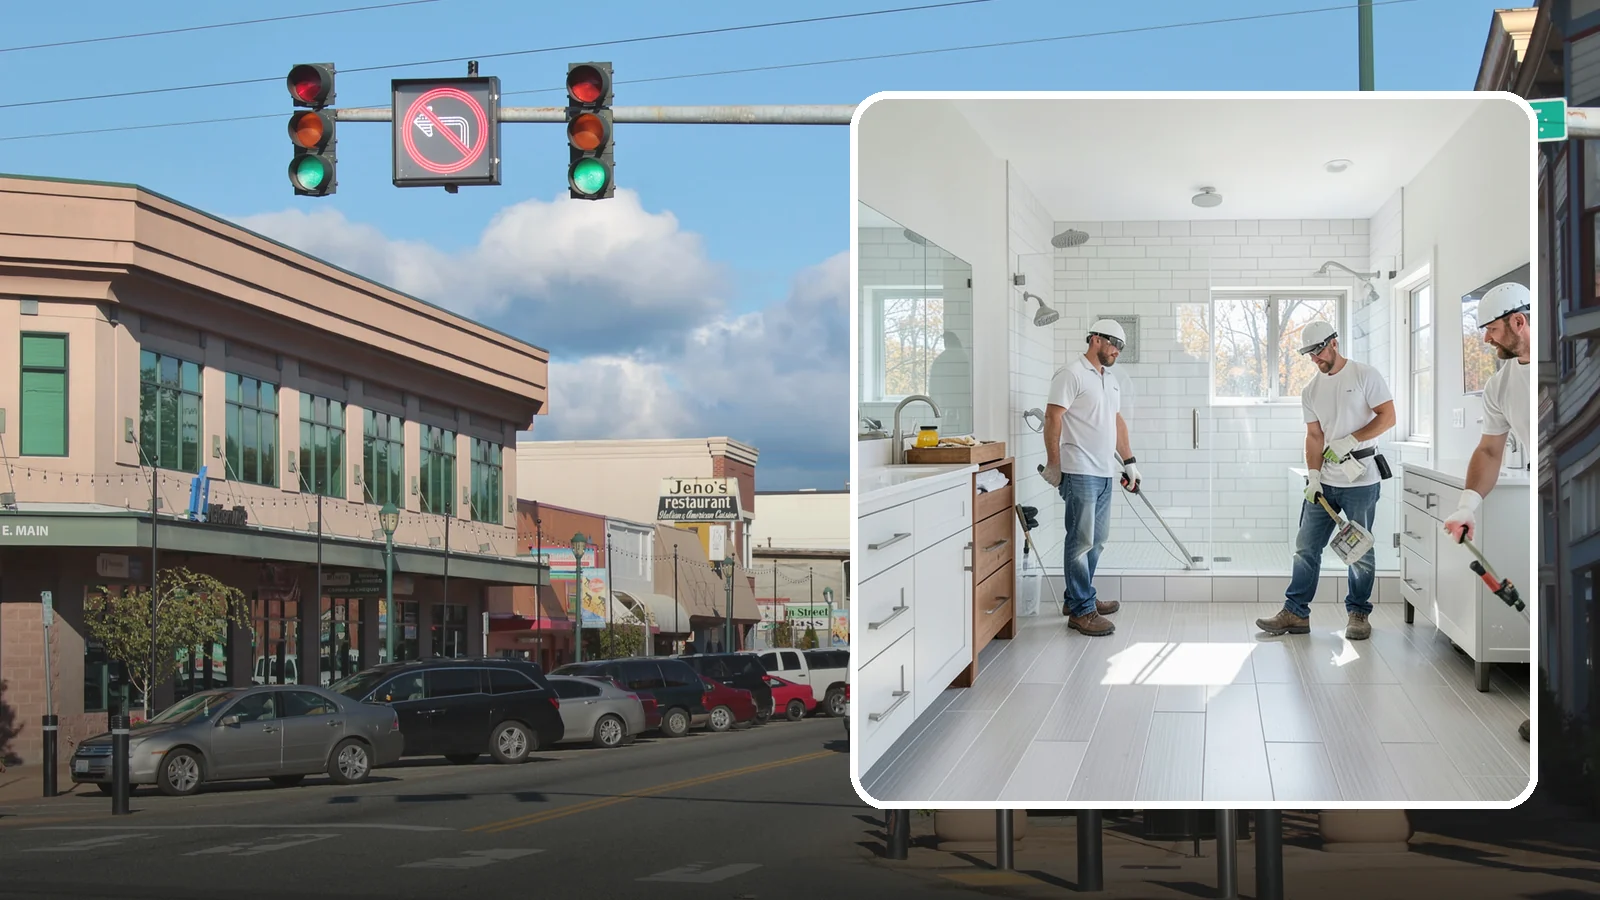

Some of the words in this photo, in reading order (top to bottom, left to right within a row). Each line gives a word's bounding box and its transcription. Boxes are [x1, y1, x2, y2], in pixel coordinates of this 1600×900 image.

[669, 480, 728, 495] Jeno's
[665, 497, 731, 509] restaurant
[658, 510, 682, 520] Italian
[686, 510, 714, 520] American
[715, 510, 738, 519] Cuisine
[2, 525, 13, 536] E.
[15, 525, 49, 536] MAIN
[797, 608, 828, 617] Street
[791, 619, 824, 627] lass
